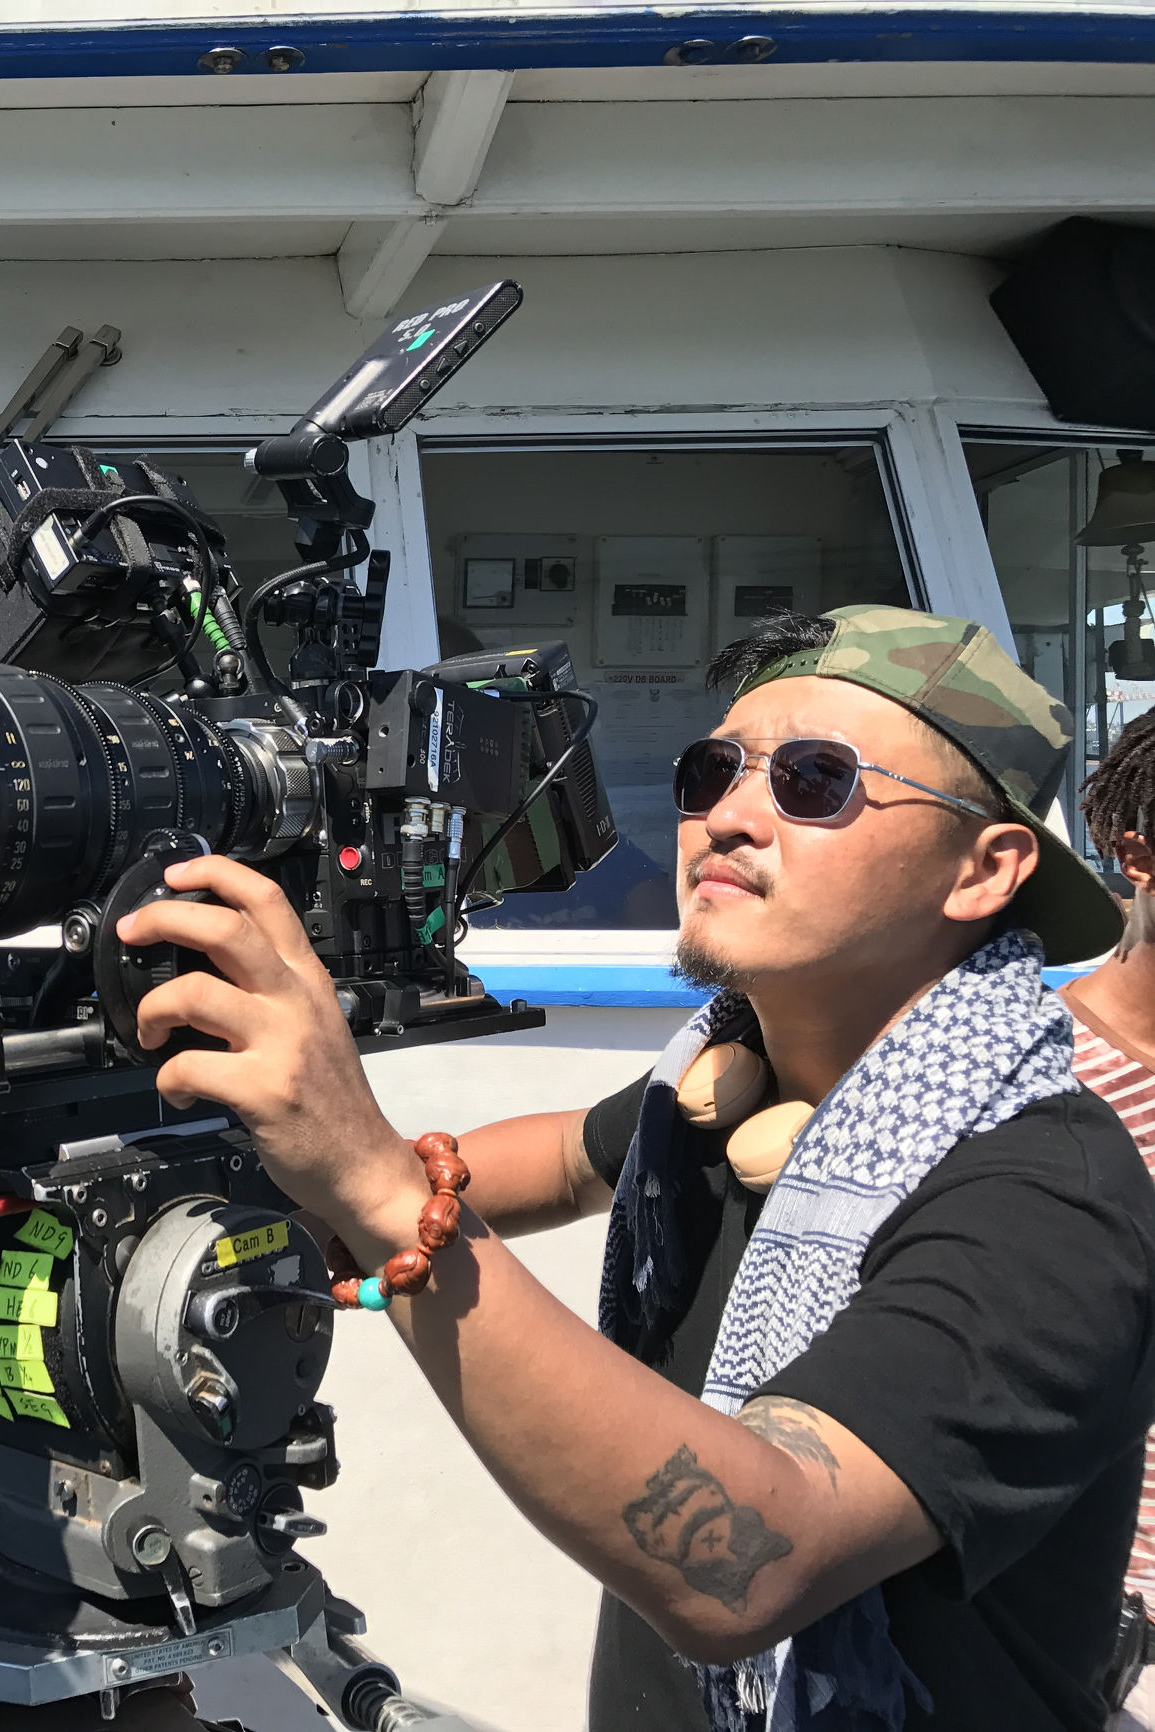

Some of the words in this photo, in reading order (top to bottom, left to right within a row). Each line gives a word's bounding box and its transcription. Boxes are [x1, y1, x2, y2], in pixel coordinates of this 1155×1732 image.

[429, 299, 470, 321] PRO
[649, 675, 677, 683] BOARD
[443, 700, 455, 784] TERADEK
[13, 778, 31, 791] 120
[17, 820, 29, 833] 40
[14, 841, 27, 854] 30
[10, 858, 23, 870] 25
[360, 878, 373, 886] REC
[232, 1235, 260, 1254] Cam
[266, 1228, 274, 1244] B
[4, 1261, 22, 1279] ND
[6, 1367, 14, 1382] B
